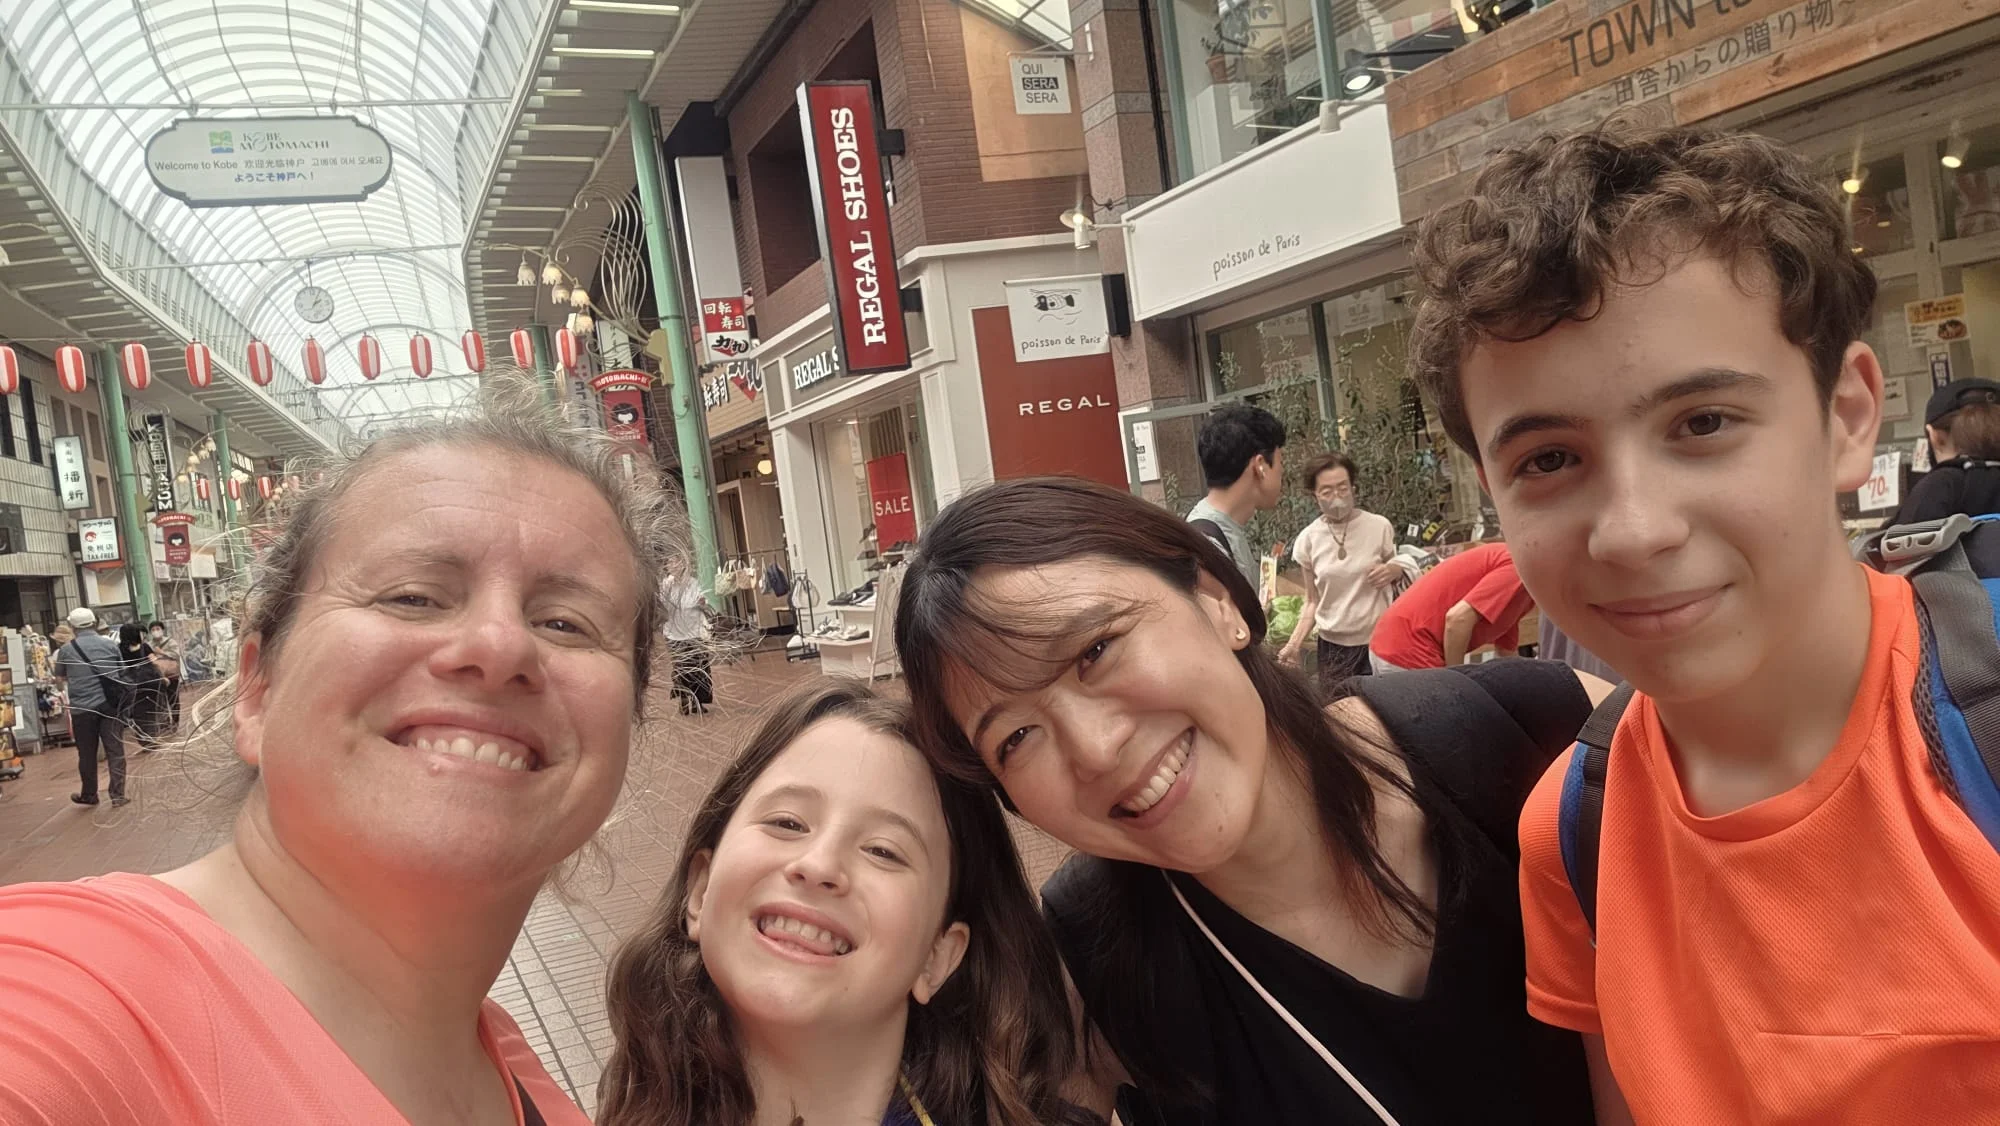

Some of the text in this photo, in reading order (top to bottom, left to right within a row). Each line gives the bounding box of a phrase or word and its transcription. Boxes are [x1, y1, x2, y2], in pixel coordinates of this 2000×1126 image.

[1559, 0, 1696, 77] TOWN
[1021, 63, 1044, 75] QUI
[1024, 78, 1057, 89] SERA
[1025, 92, 1059, 104] SERA
[239, 139, 330, 152] MOTOMACHI
[243, 131, 281, 143] KOBE
[154, 160, 238, 171] Welcome to Kobe
[830, 107, 887, 346] REGAL SHOES
[1213, 233, 1301, 282] poisson de Paris
[703, 301, 733, 315] 回転
[720, 314, 746, 330] 寿司
[1021, 334, 1102, 354] poisson de Paris
[792, 351, 833, 390] REGAL
[1018, 394, 1111, 416] REGAL
[1867, 475, 1887, 499] 70
[875, 495, 911, 517] SALE
